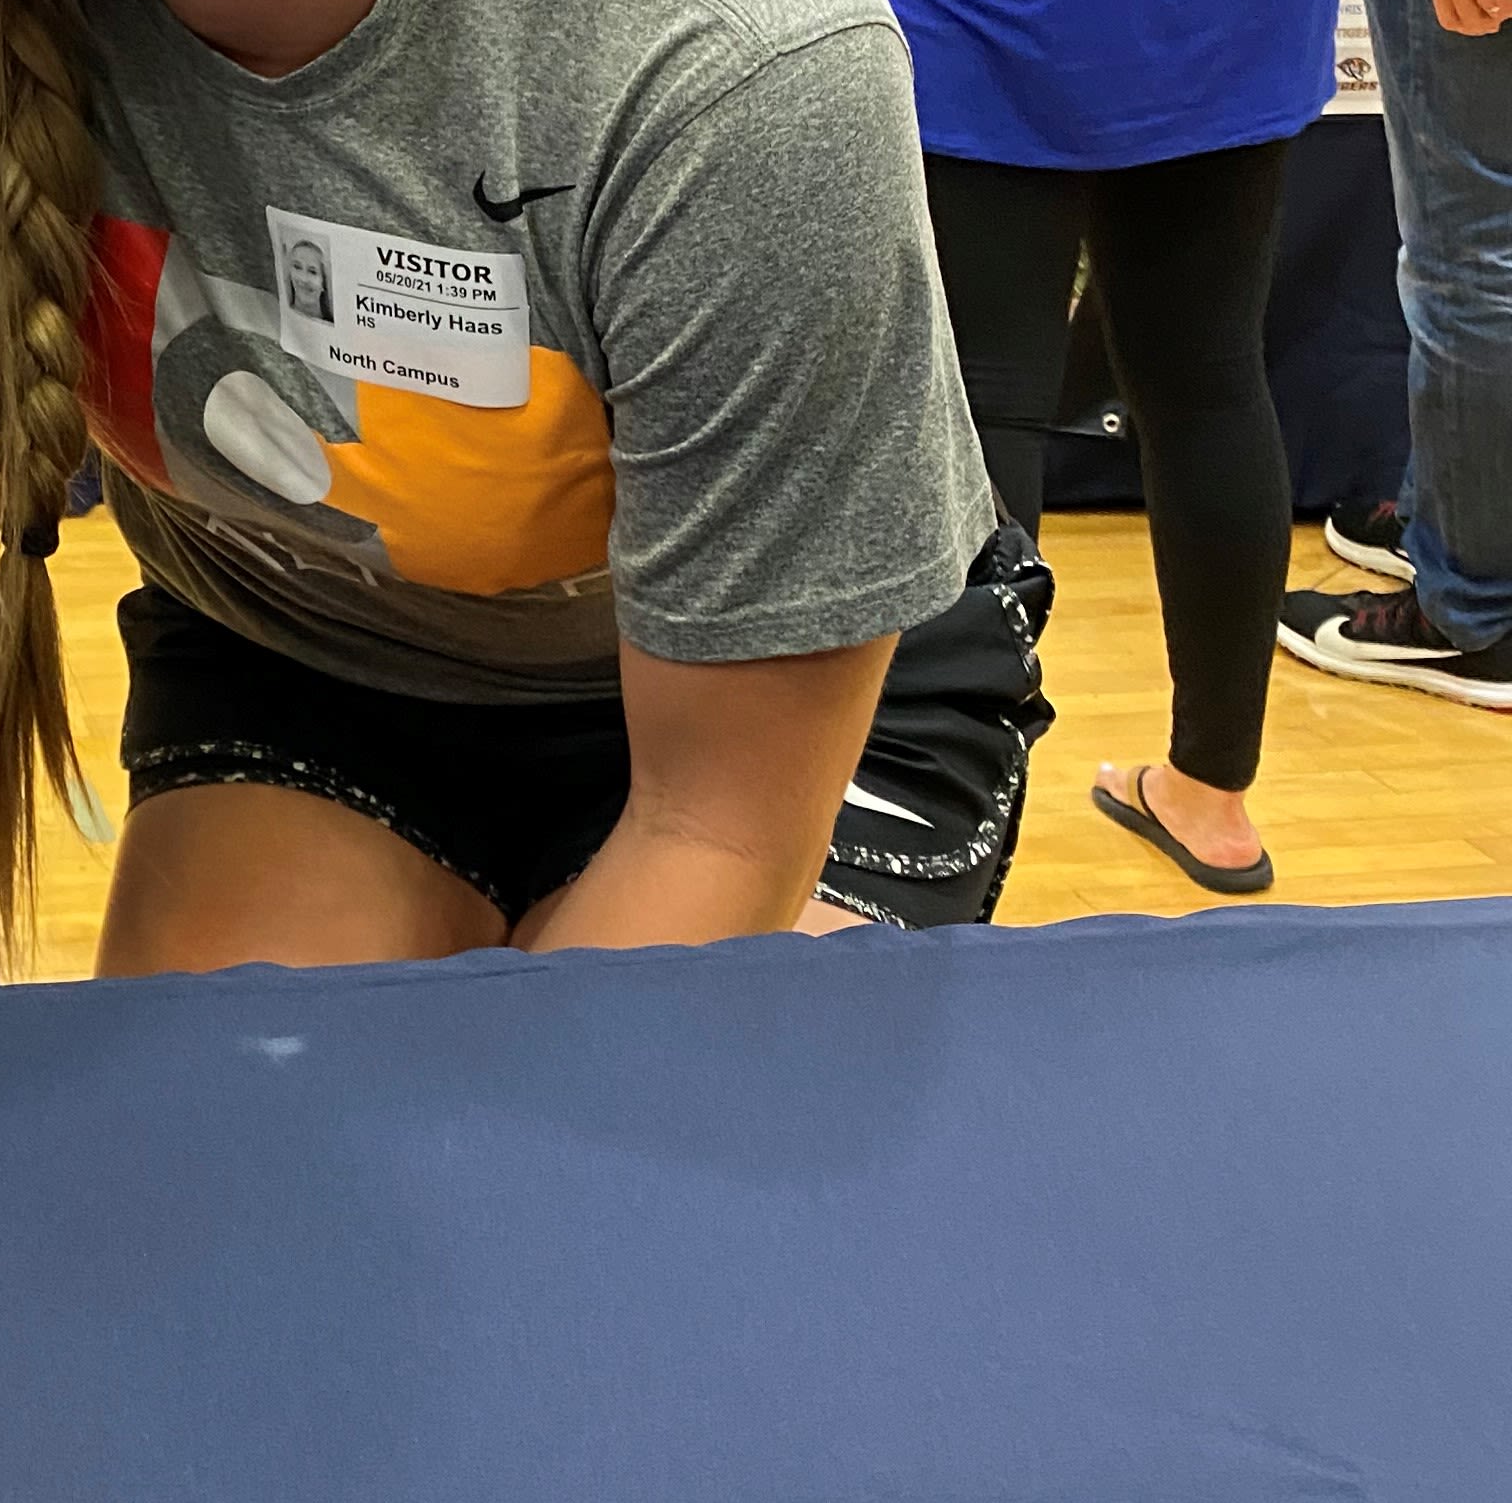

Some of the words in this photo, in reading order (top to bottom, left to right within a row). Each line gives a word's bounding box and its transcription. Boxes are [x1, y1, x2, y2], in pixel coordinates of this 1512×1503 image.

[376, 246, 493, 284] VISITOR
[376, 270, 431, 292] 05/20/21
[437, 283, 467, 298] 1:39
[472, 289, 497, 301] PM
[356, 294, 442, 331] Kimberly
[449, 314, 503, 335] Haas
[356, 315, 376, 329] HS
[329, 344, 377, 371] North
[383, 360, 460, 389] Campus
